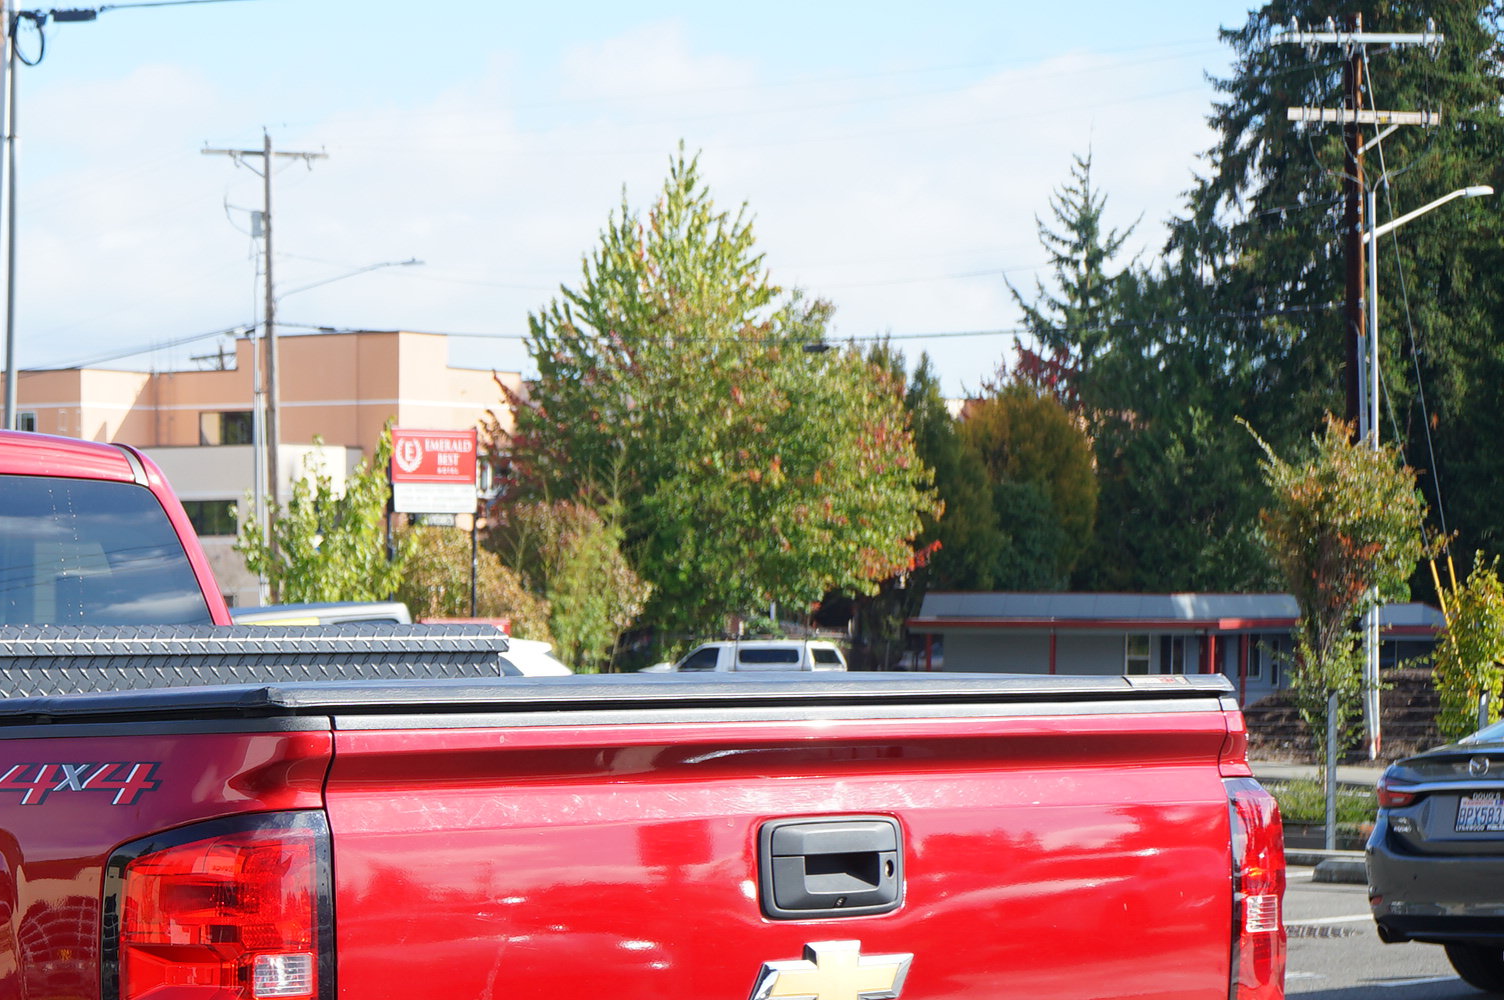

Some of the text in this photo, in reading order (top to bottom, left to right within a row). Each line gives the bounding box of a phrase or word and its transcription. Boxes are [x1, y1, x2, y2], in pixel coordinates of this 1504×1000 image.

[425, 438, 473, 452] EMERALD
[437, 453, 460, 466] BEST
[1457, 807, 1504, 826] BPX583
